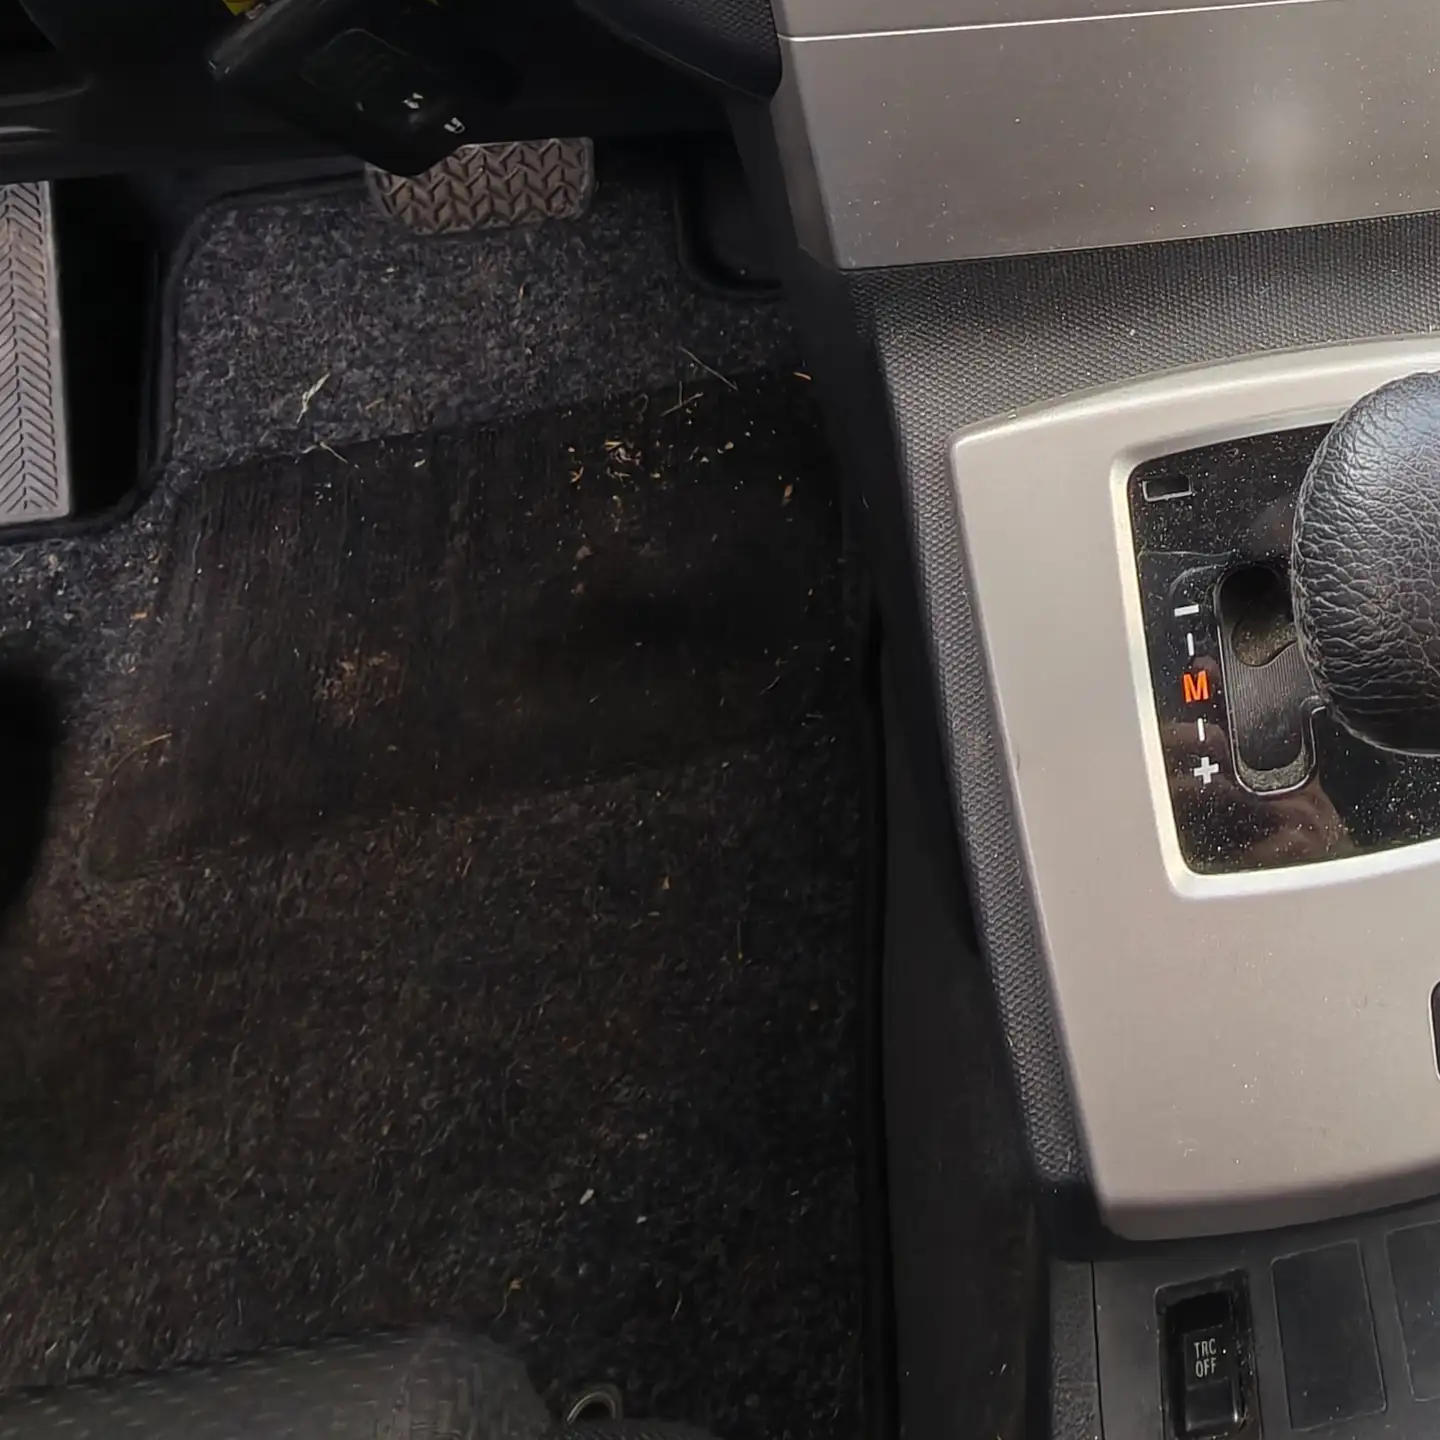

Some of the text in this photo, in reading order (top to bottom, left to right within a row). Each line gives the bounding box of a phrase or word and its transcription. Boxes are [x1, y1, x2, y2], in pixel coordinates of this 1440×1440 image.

[1182, 669, 1211, 704] M
[1193, 1337, 1218, 1360] TRC
[1195, 1356, 1218, 1378] OFF
